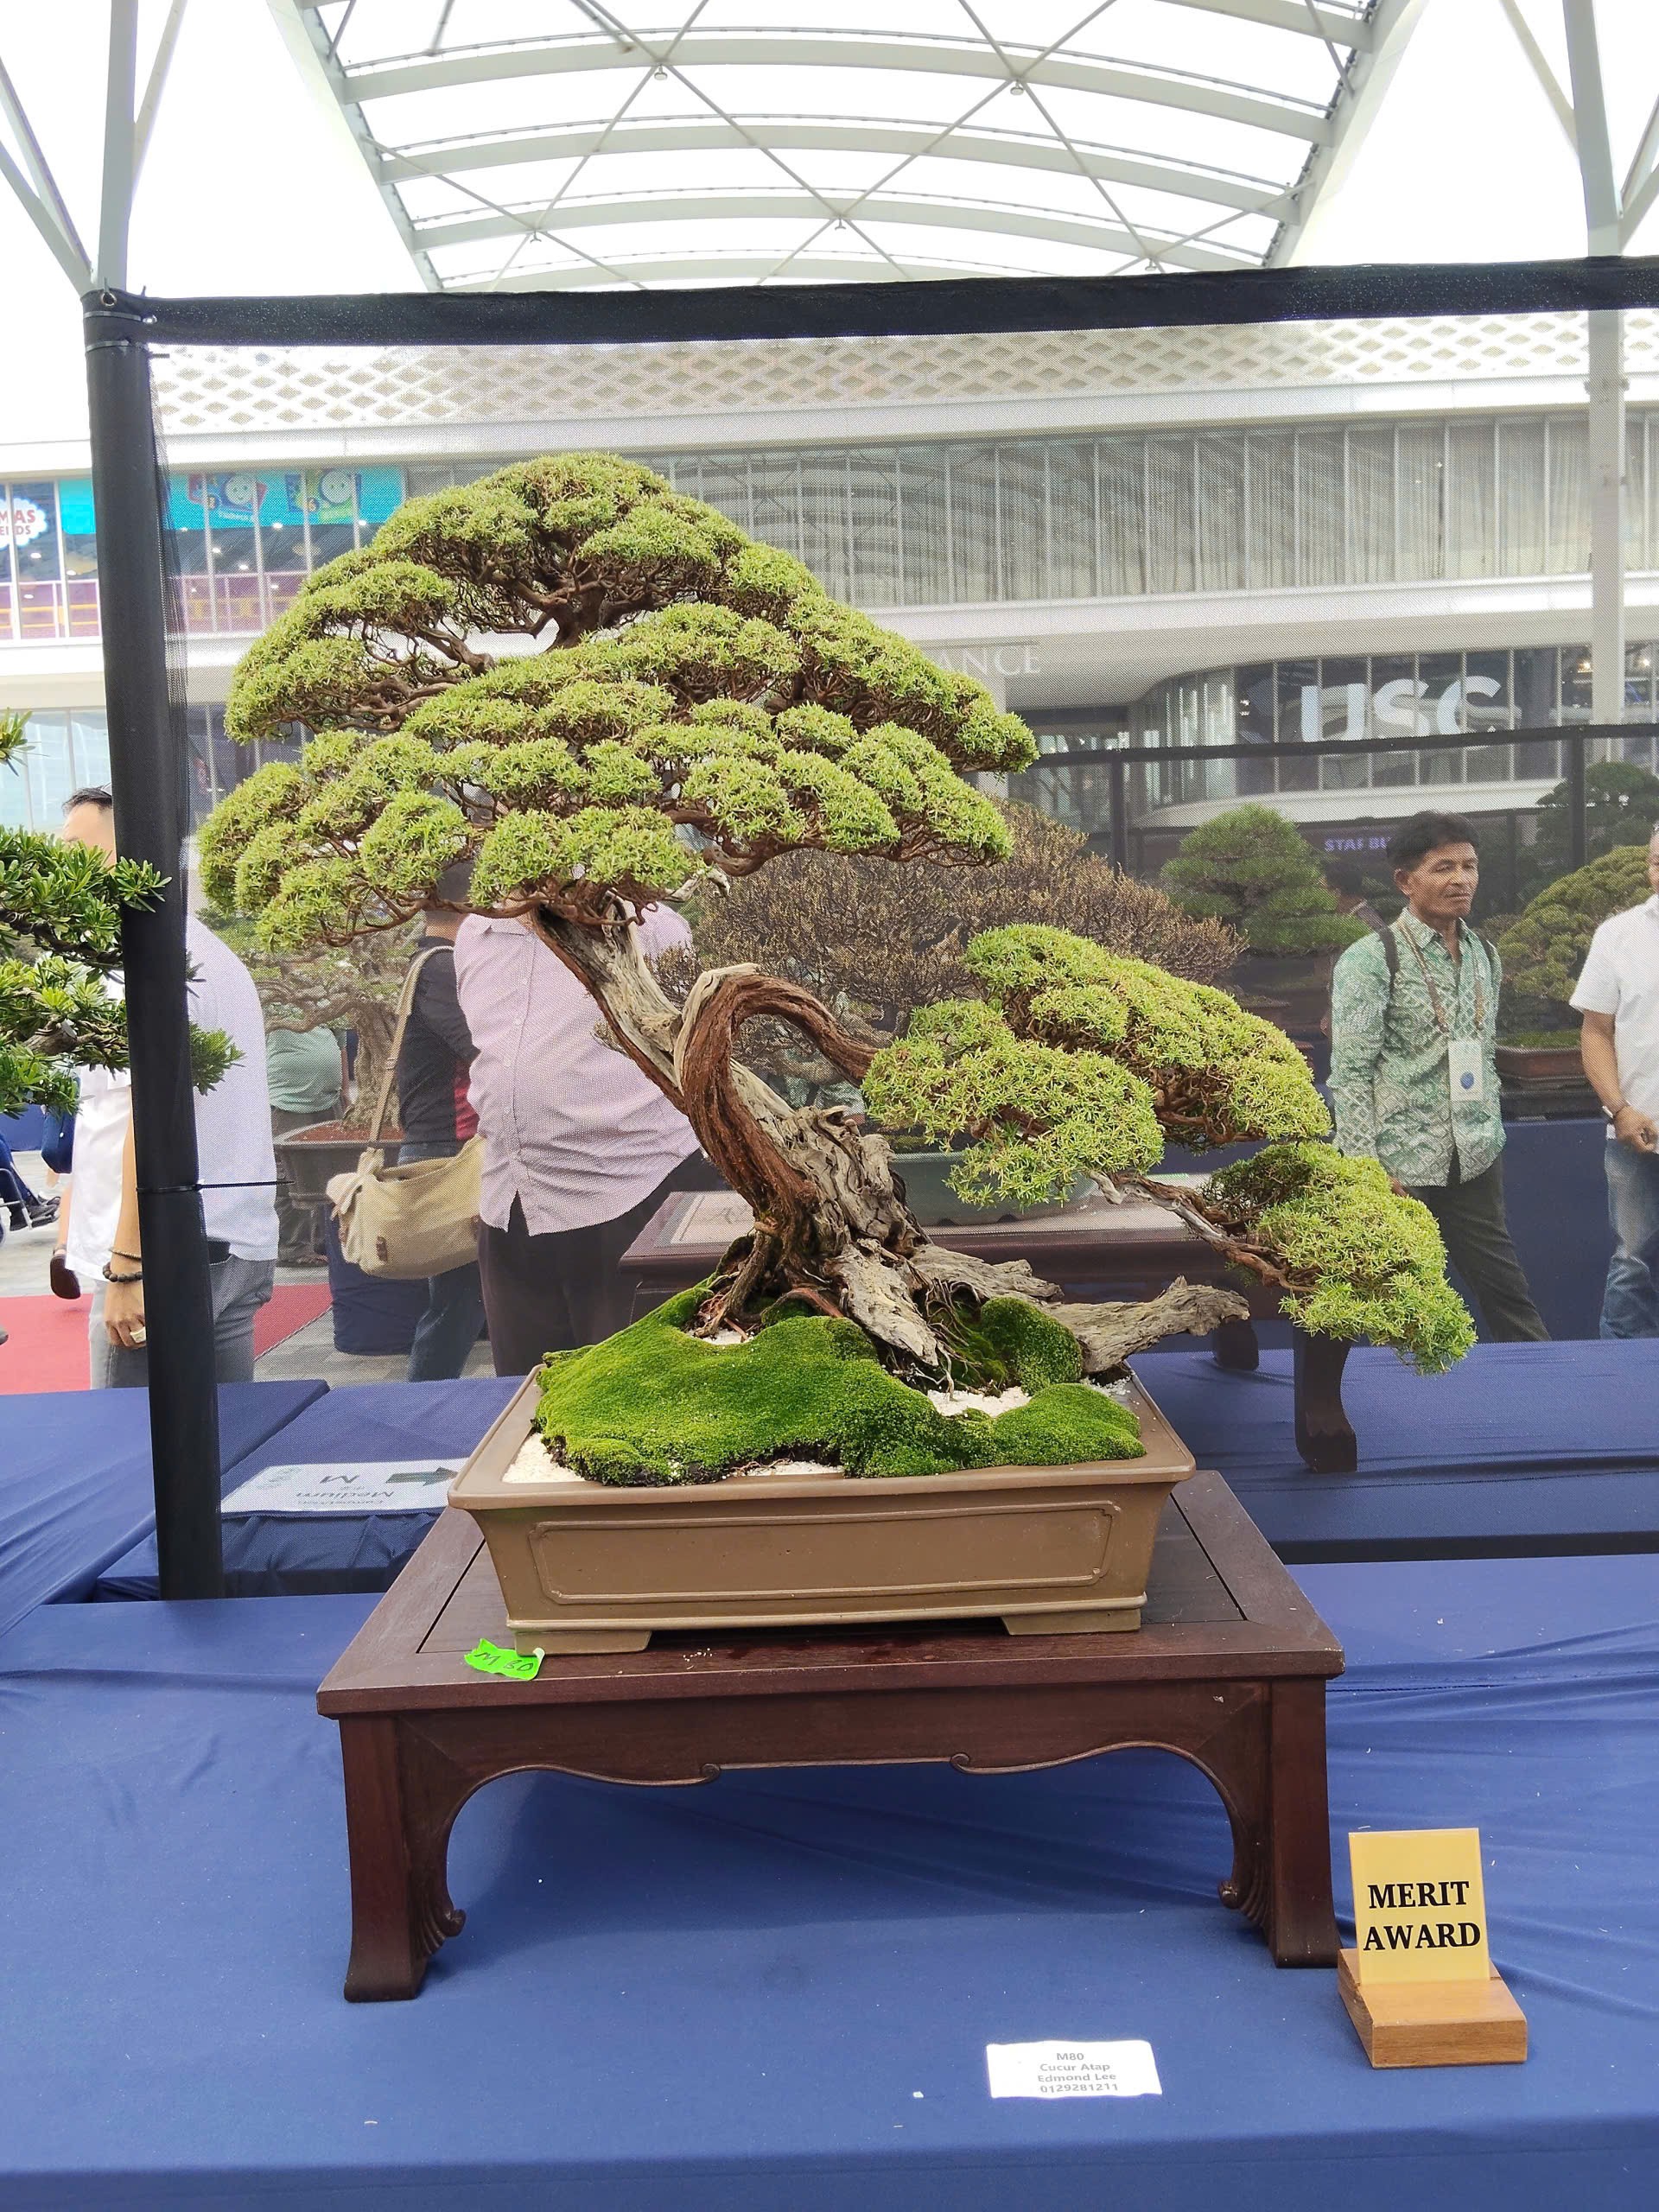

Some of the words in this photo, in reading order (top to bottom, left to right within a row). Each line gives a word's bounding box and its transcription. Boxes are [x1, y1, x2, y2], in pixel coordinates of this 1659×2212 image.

[1367, 1881, 1470, 1909] MERIT
[1363, 1923, 1481, 1951] AWARD
[1056, 2052, 1084, 2061] M80
[1039, 2063, 1077, 2072] Cucur
[1080, 2063, 1110, 2072] Atap
[1038, 2074, 1090, 2083] Edmond
[1095, 2073, 1117, 2082] Lee
[1039, 2082, 1118, 2094] 0129281211
